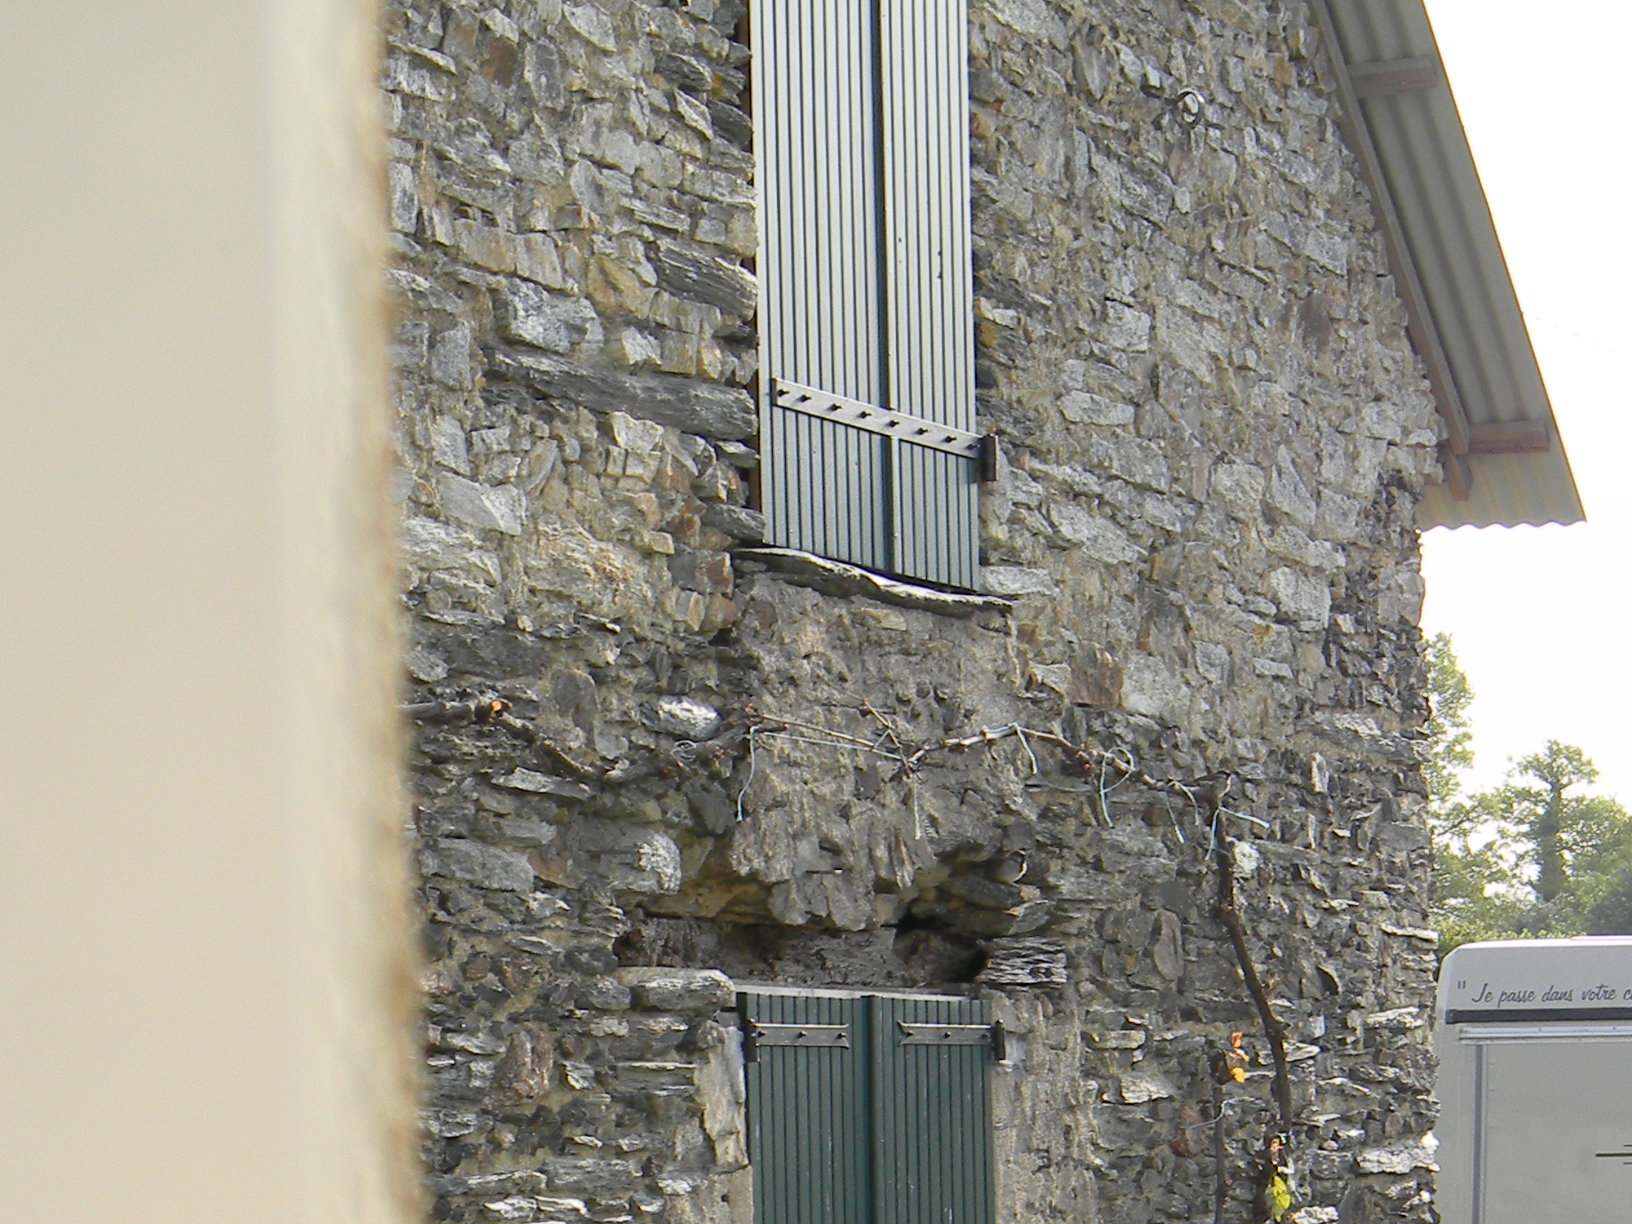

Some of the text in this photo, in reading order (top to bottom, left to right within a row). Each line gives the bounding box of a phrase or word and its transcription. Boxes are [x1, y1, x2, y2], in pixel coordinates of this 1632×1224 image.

[1497, 990, 1536, 1008] passe
[1541, 984, 1573, 1002] dans
[1581, 983, 1616, 1001] votre
